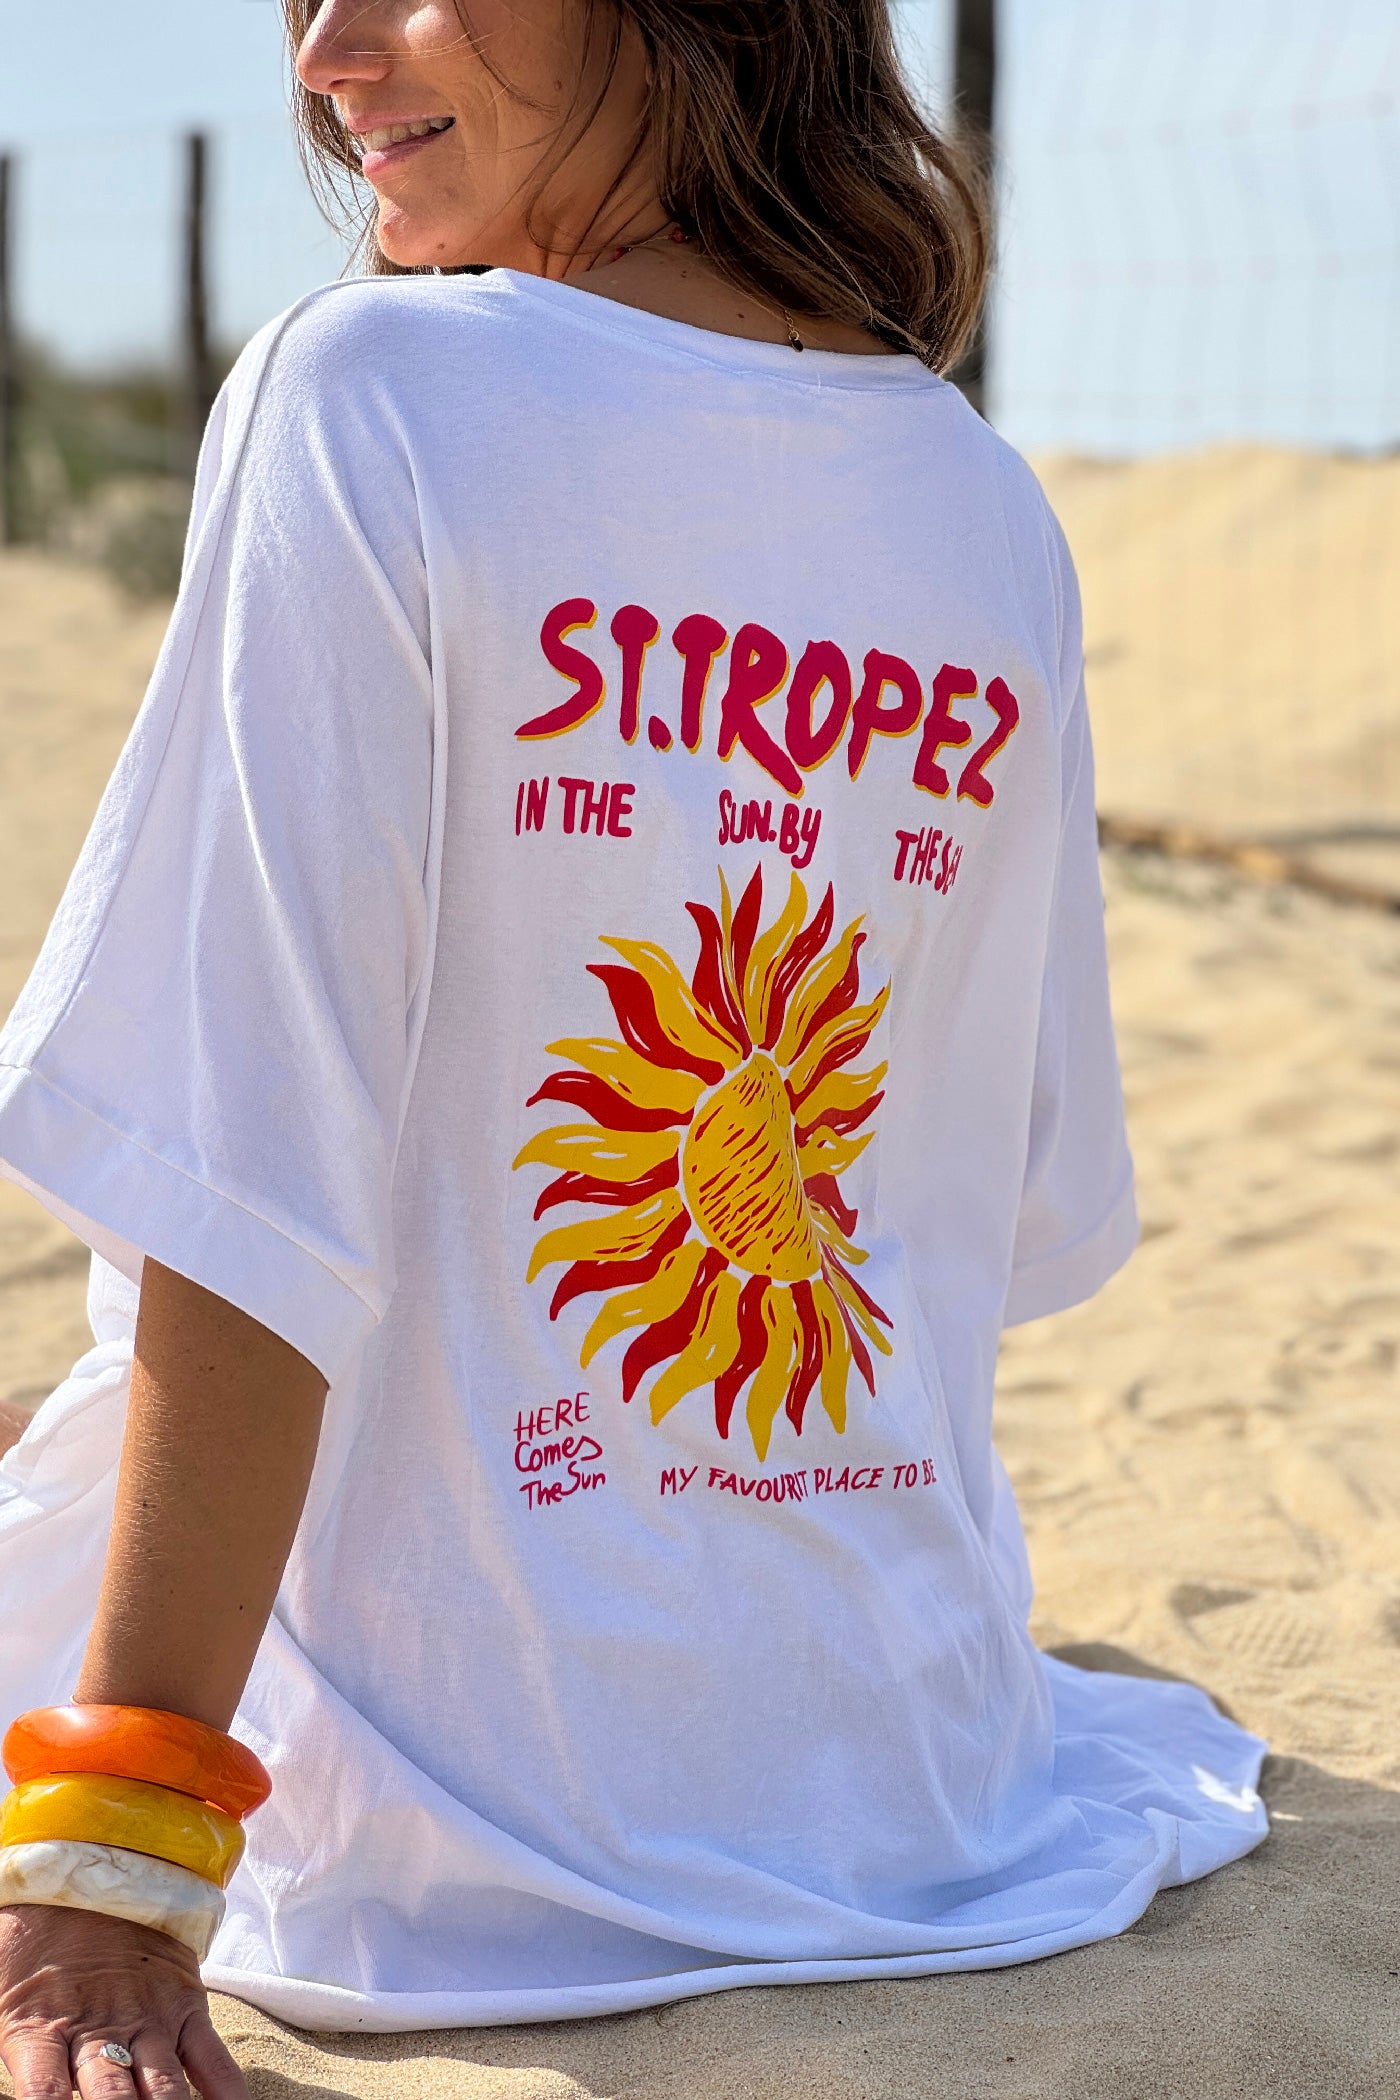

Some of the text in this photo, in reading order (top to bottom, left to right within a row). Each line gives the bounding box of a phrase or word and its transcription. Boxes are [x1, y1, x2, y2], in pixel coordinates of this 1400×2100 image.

[515, 776, 549, 836] IN
[558, 776, 635, 838] THE
[513, 1391, 590, 1442] HERE
[514, 1435, 603, 1473] Comes
[660, 1465, 698, 1496] MY
[813, 1466, 885, 1494] PLACE
[893, 1463, 918, 1489] TO
[922, 1458, 937, 1486] BE
